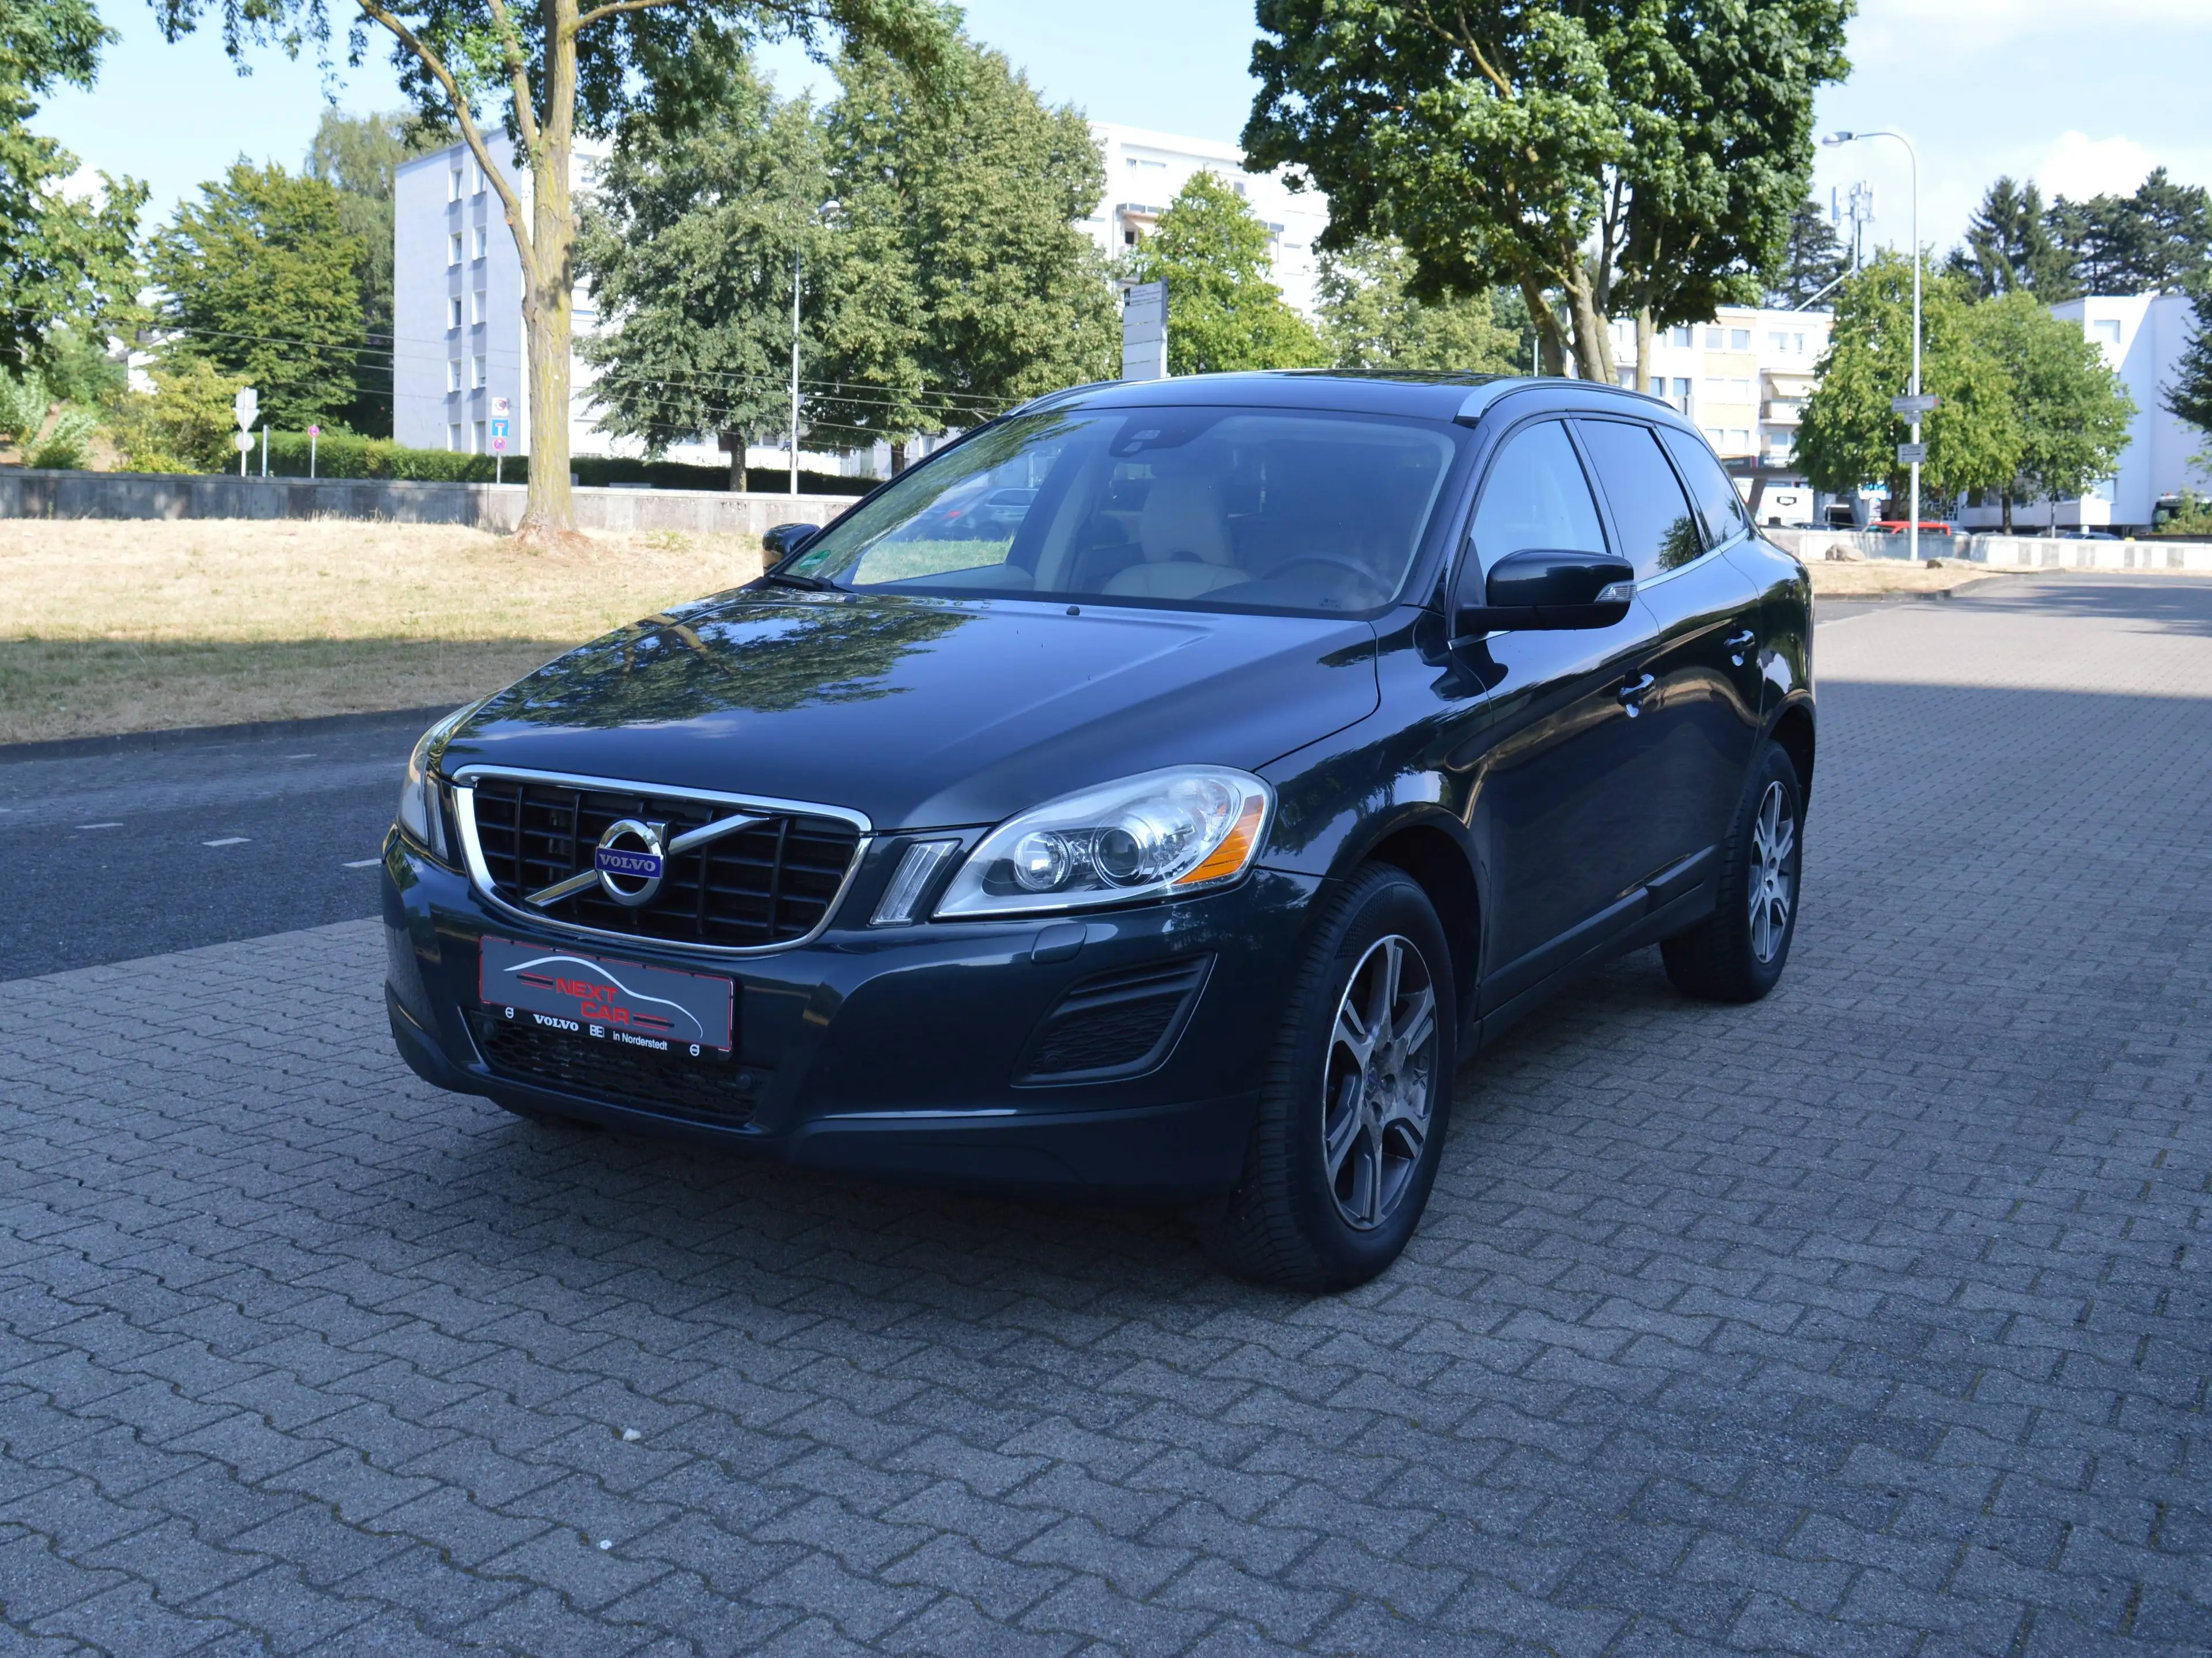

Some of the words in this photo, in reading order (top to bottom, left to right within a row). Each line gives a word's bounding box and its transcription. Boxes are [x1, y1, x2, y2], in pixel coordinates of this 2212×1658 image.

[599, 854, 656, 871] VOLVO
[556, 977, 618, 1003] NEXT
[581, 1001, 630, 1025] CAR
[533, 1014, 579, 1031] VOLVO
[613, 1031, 620, 1041] in
[622, 1033, 668, 1050] Norderstedt
